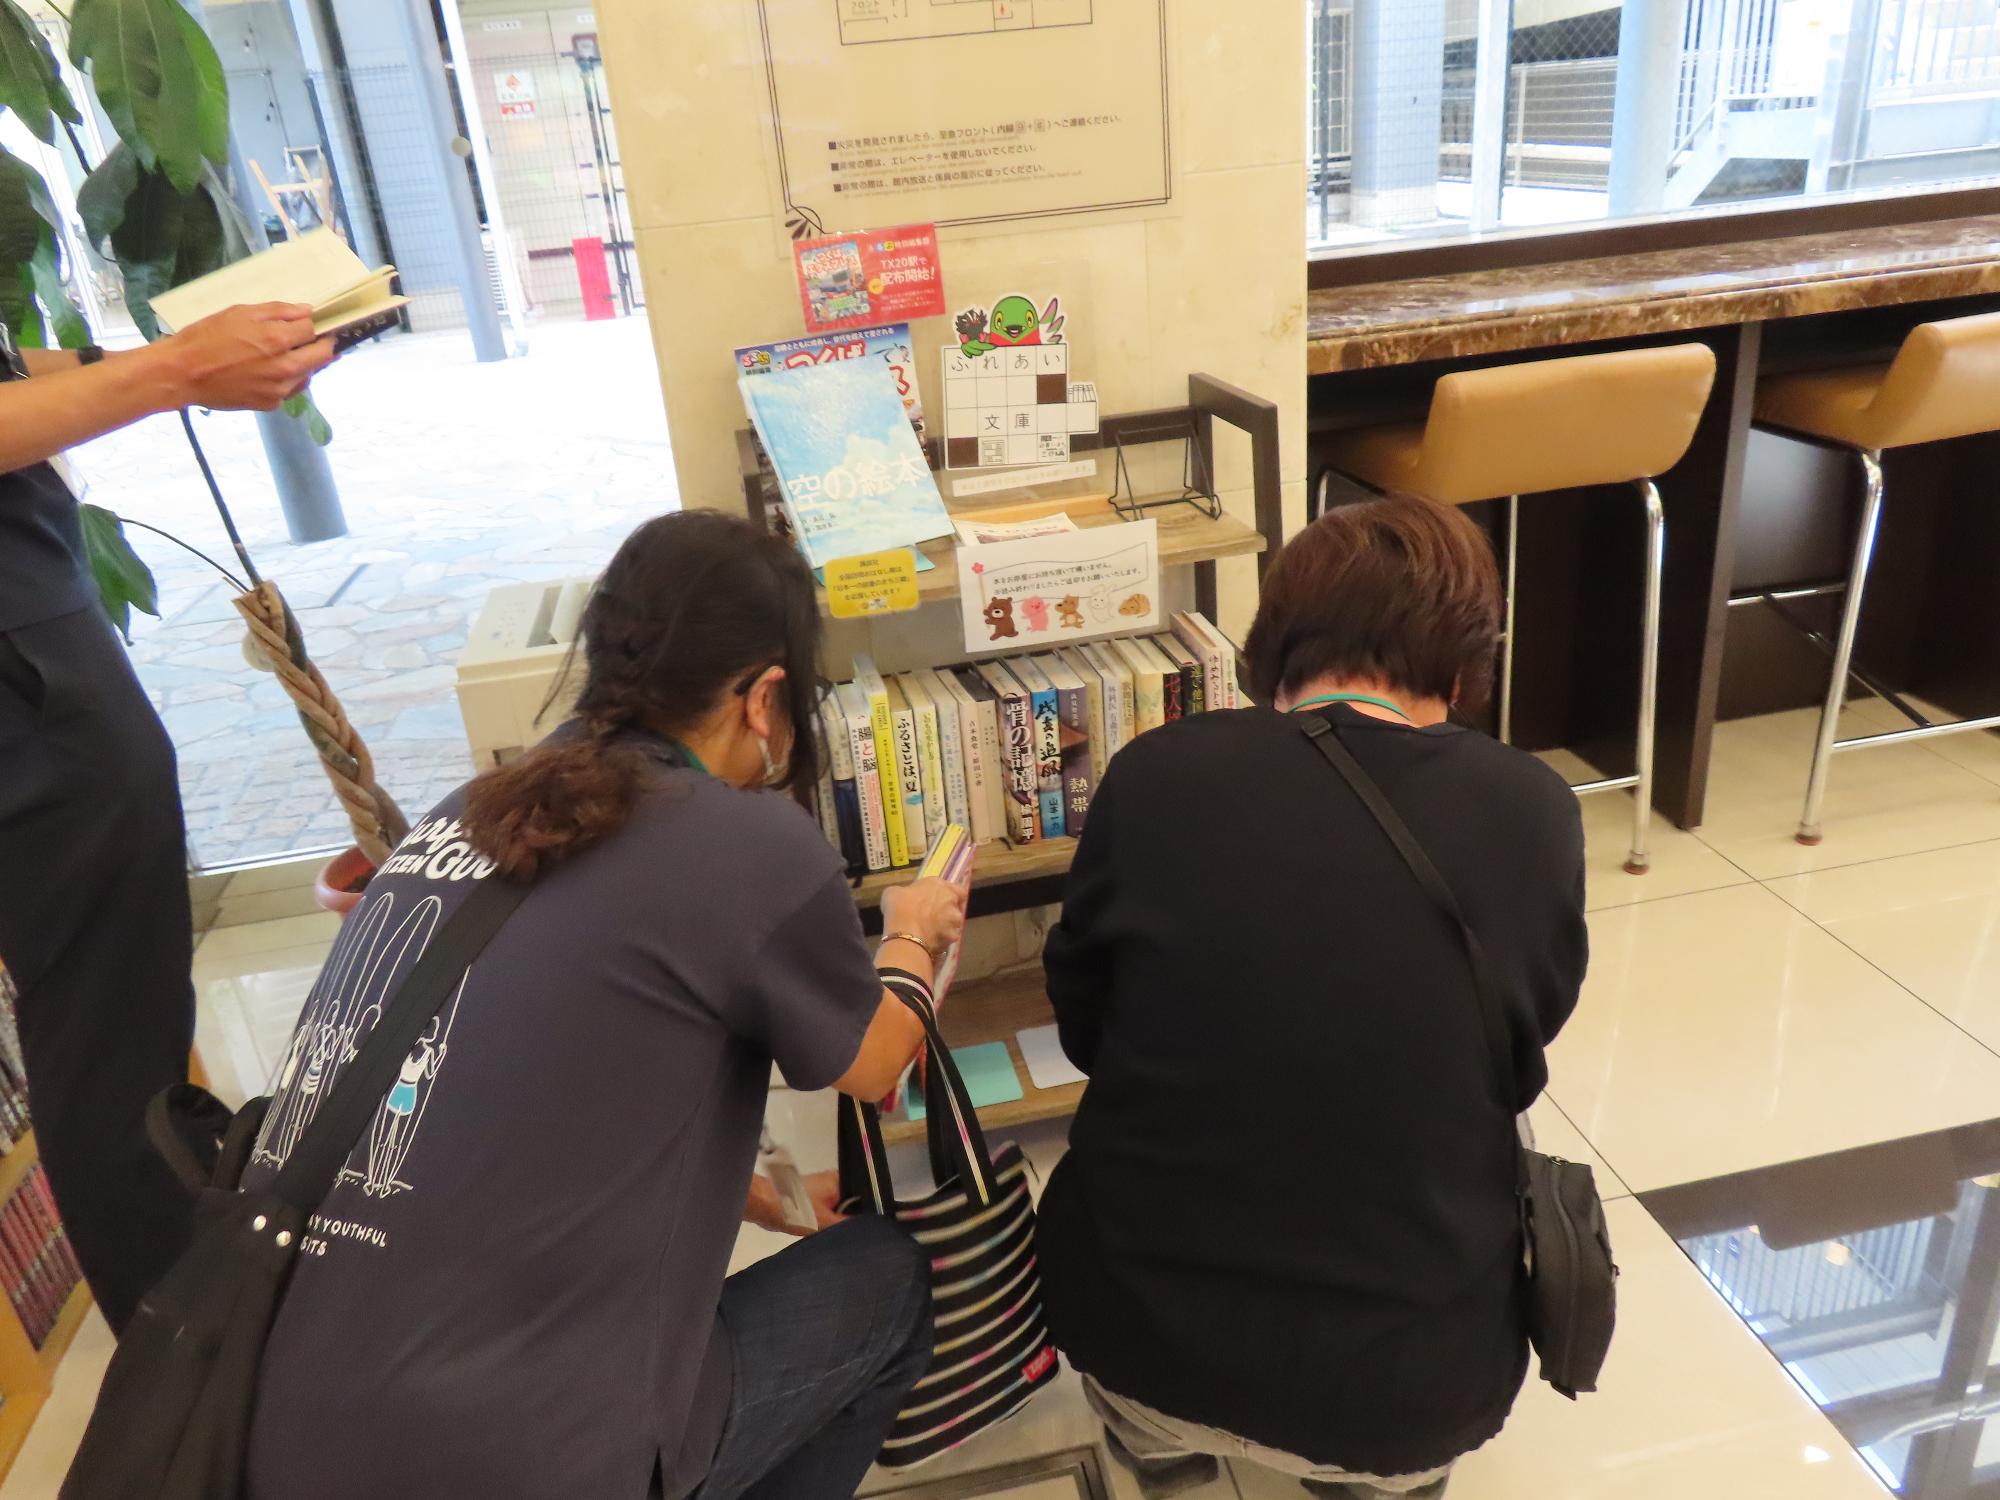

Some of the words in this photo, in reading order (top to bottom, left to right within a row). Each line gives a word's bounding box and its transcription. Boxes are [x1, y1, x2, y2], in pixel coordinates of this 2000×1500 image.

[951, 353, 1061, 373] ふれあい
[985, 413, 1031, 430] 文庫
[787, 452, 929, 512] 空の絵本
[1069, 777, 1089, 813] 熱帯
[322, 1218, 387, 1248] YOUTHFUL
